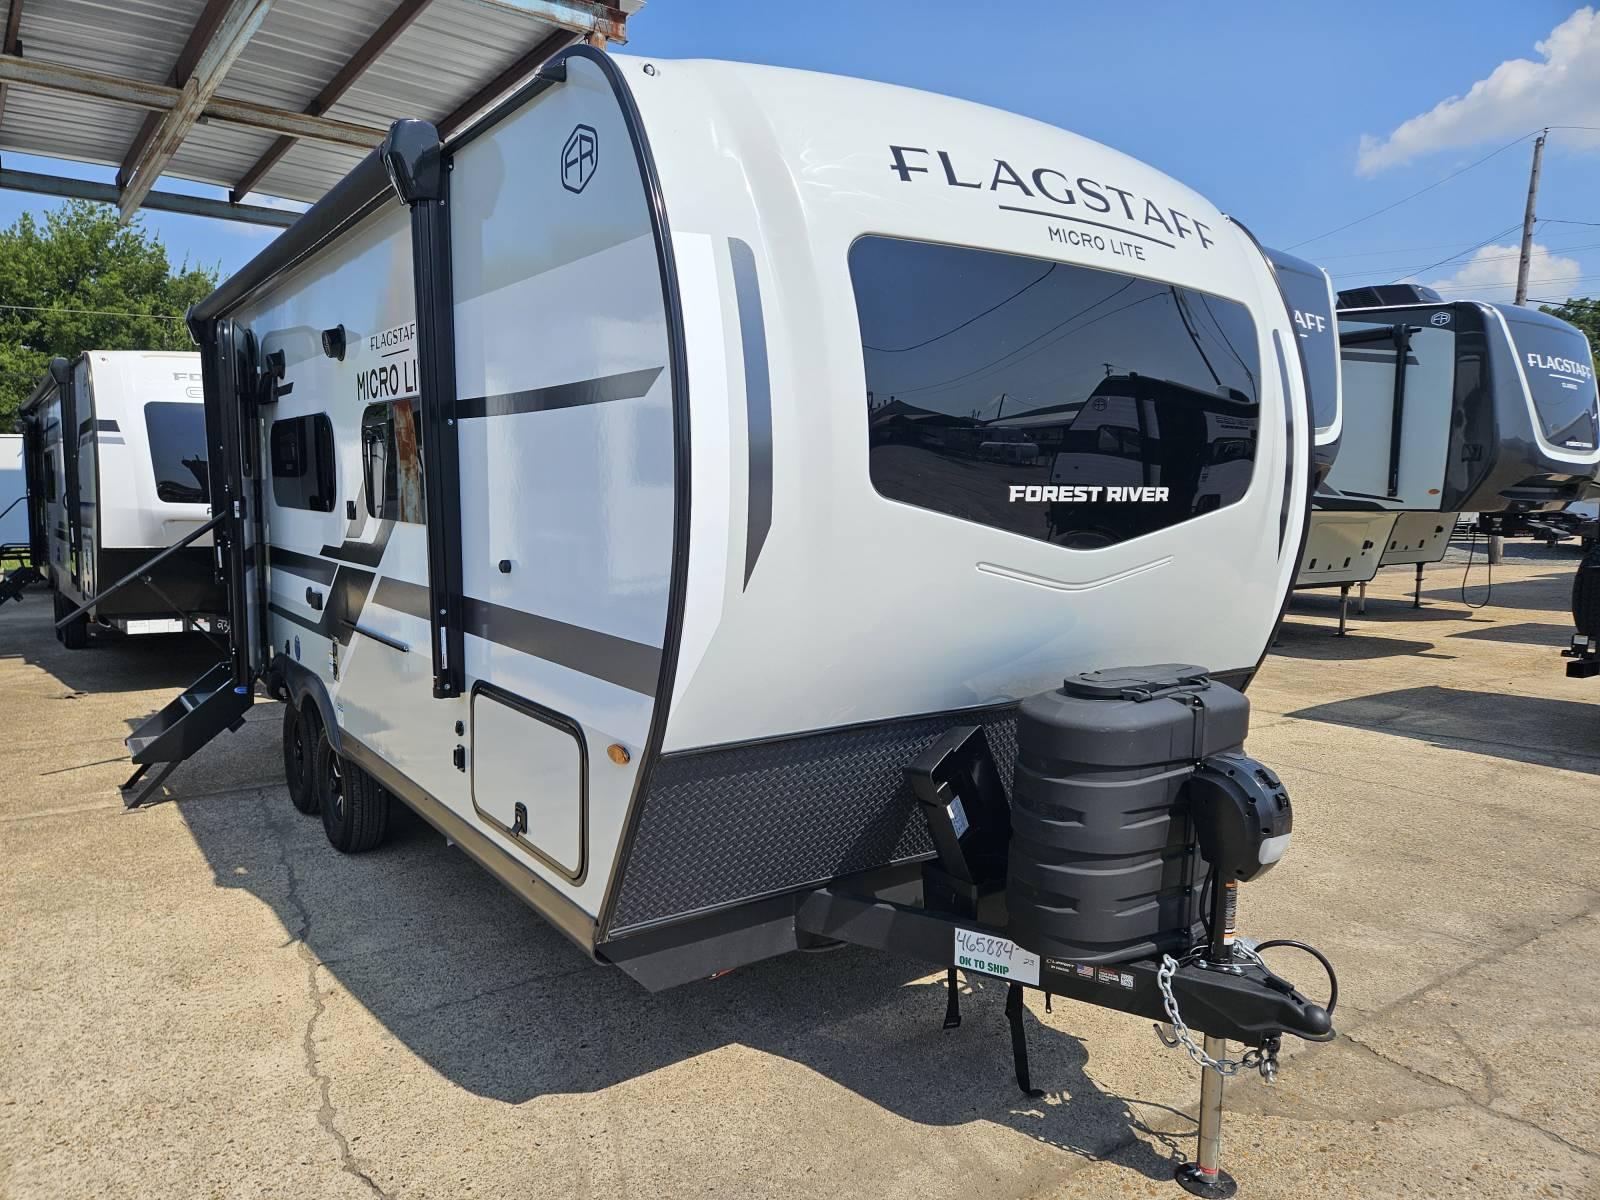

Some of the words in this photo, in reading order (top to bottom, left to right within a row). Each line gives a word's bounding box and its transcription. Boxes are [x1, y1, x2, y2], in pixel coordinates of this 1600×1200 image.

[889, 144, 1214, 249] FLAGSTAFF
[1047, 225, 1106, 251] MICRO
[1110, 238, 1147, 261] LITE
[370, 323, 416, 351] FLAGSTAF
[356, 363, 399, 401] MICRO
[404, 359, 417, 393] LI
[1527, 353, 1592, 379] FLAGSTAFF
[1008, 485, 1103, 503] FOREST
[1106, 486, 1170, 503] RIVER
[959, 955, 972, 967] OK
[974, 958, 985, 970] TO
[987, 962, 1010, 975] SHIP
